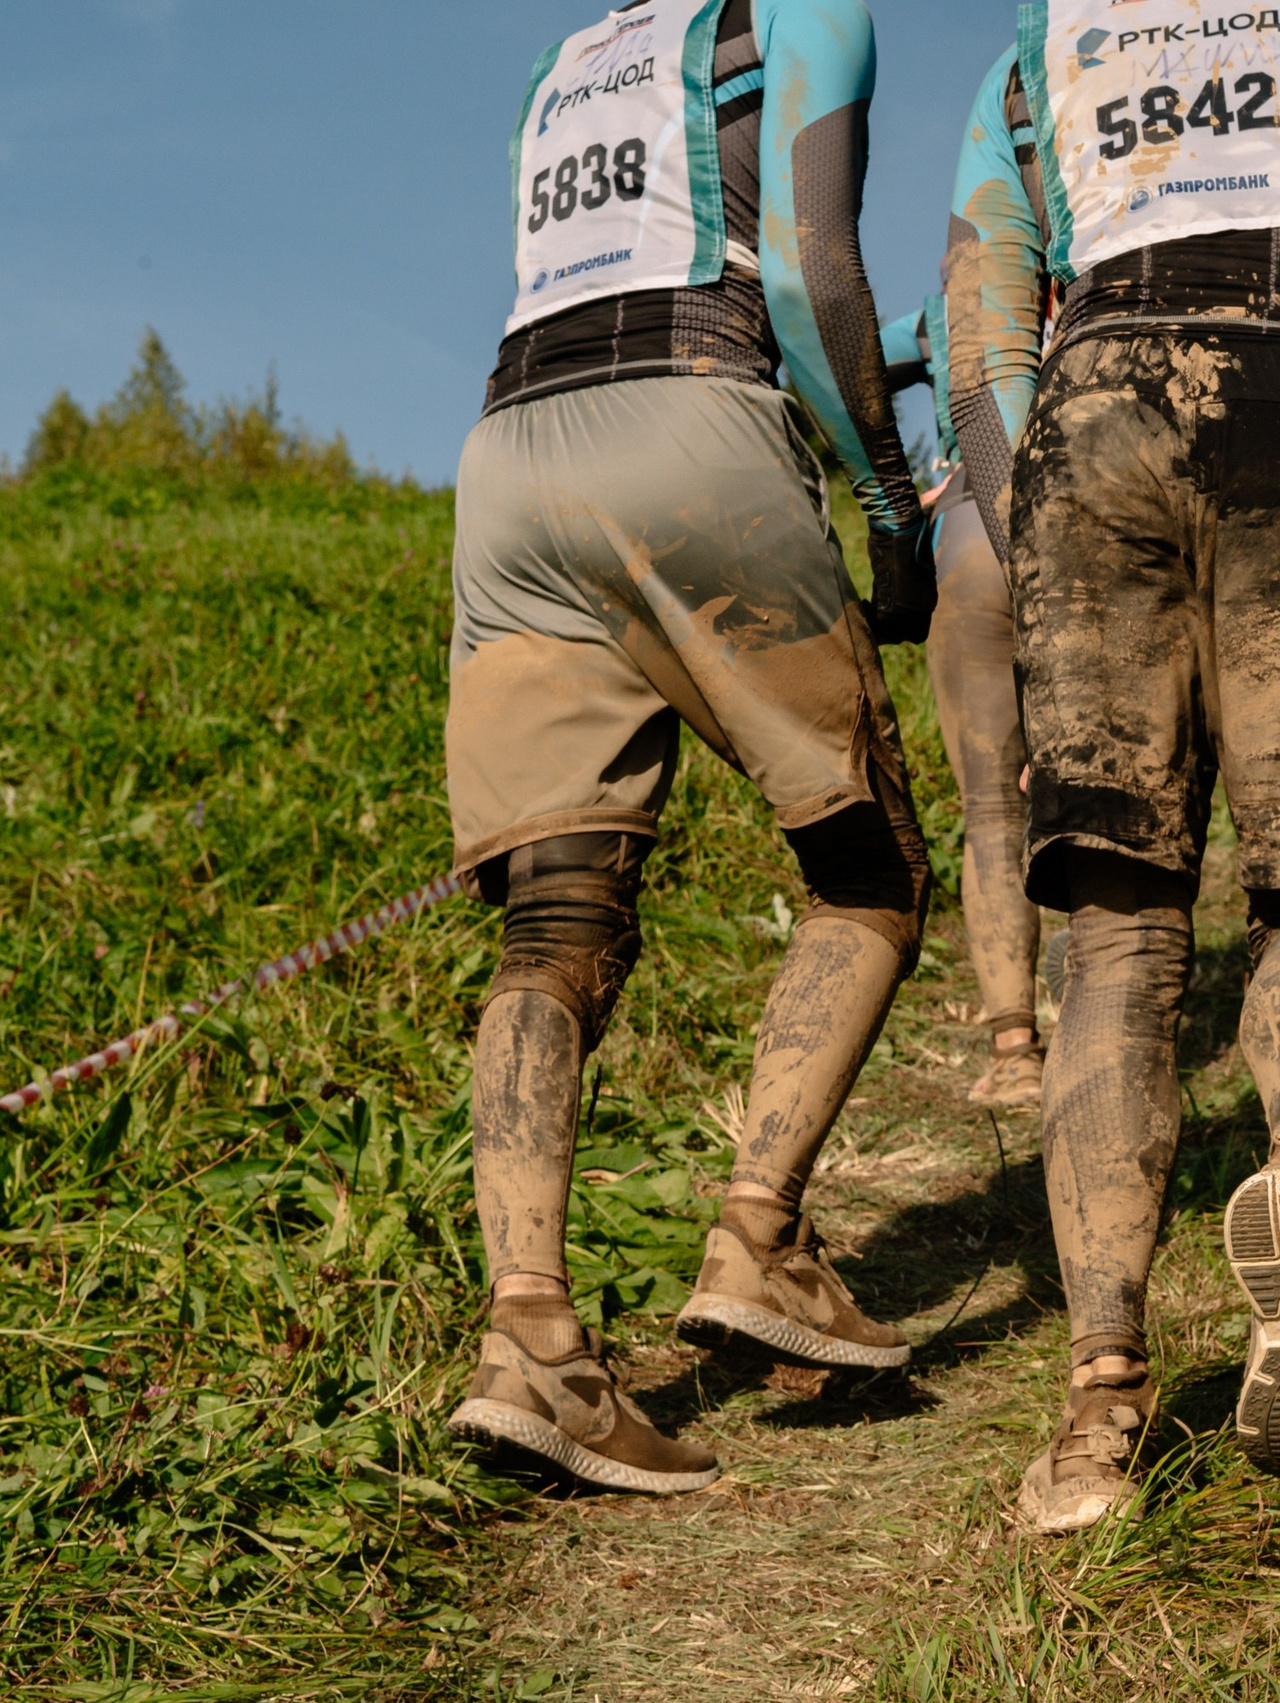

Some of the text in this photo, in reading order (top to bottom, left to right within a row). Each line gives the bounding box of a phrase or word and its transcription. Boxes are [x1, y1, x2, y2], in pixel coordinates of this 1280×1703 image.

[557, 57, 655, 117] РТК-ЦОД
[1096, 71, 1280, 160] 5842
[528, 137, 646, 235] 5838
[1158, 174, 1270, 197] ГАЗПРОМБАНК
[553, 248, 633, 282] ГАЗПРОМБАНК
